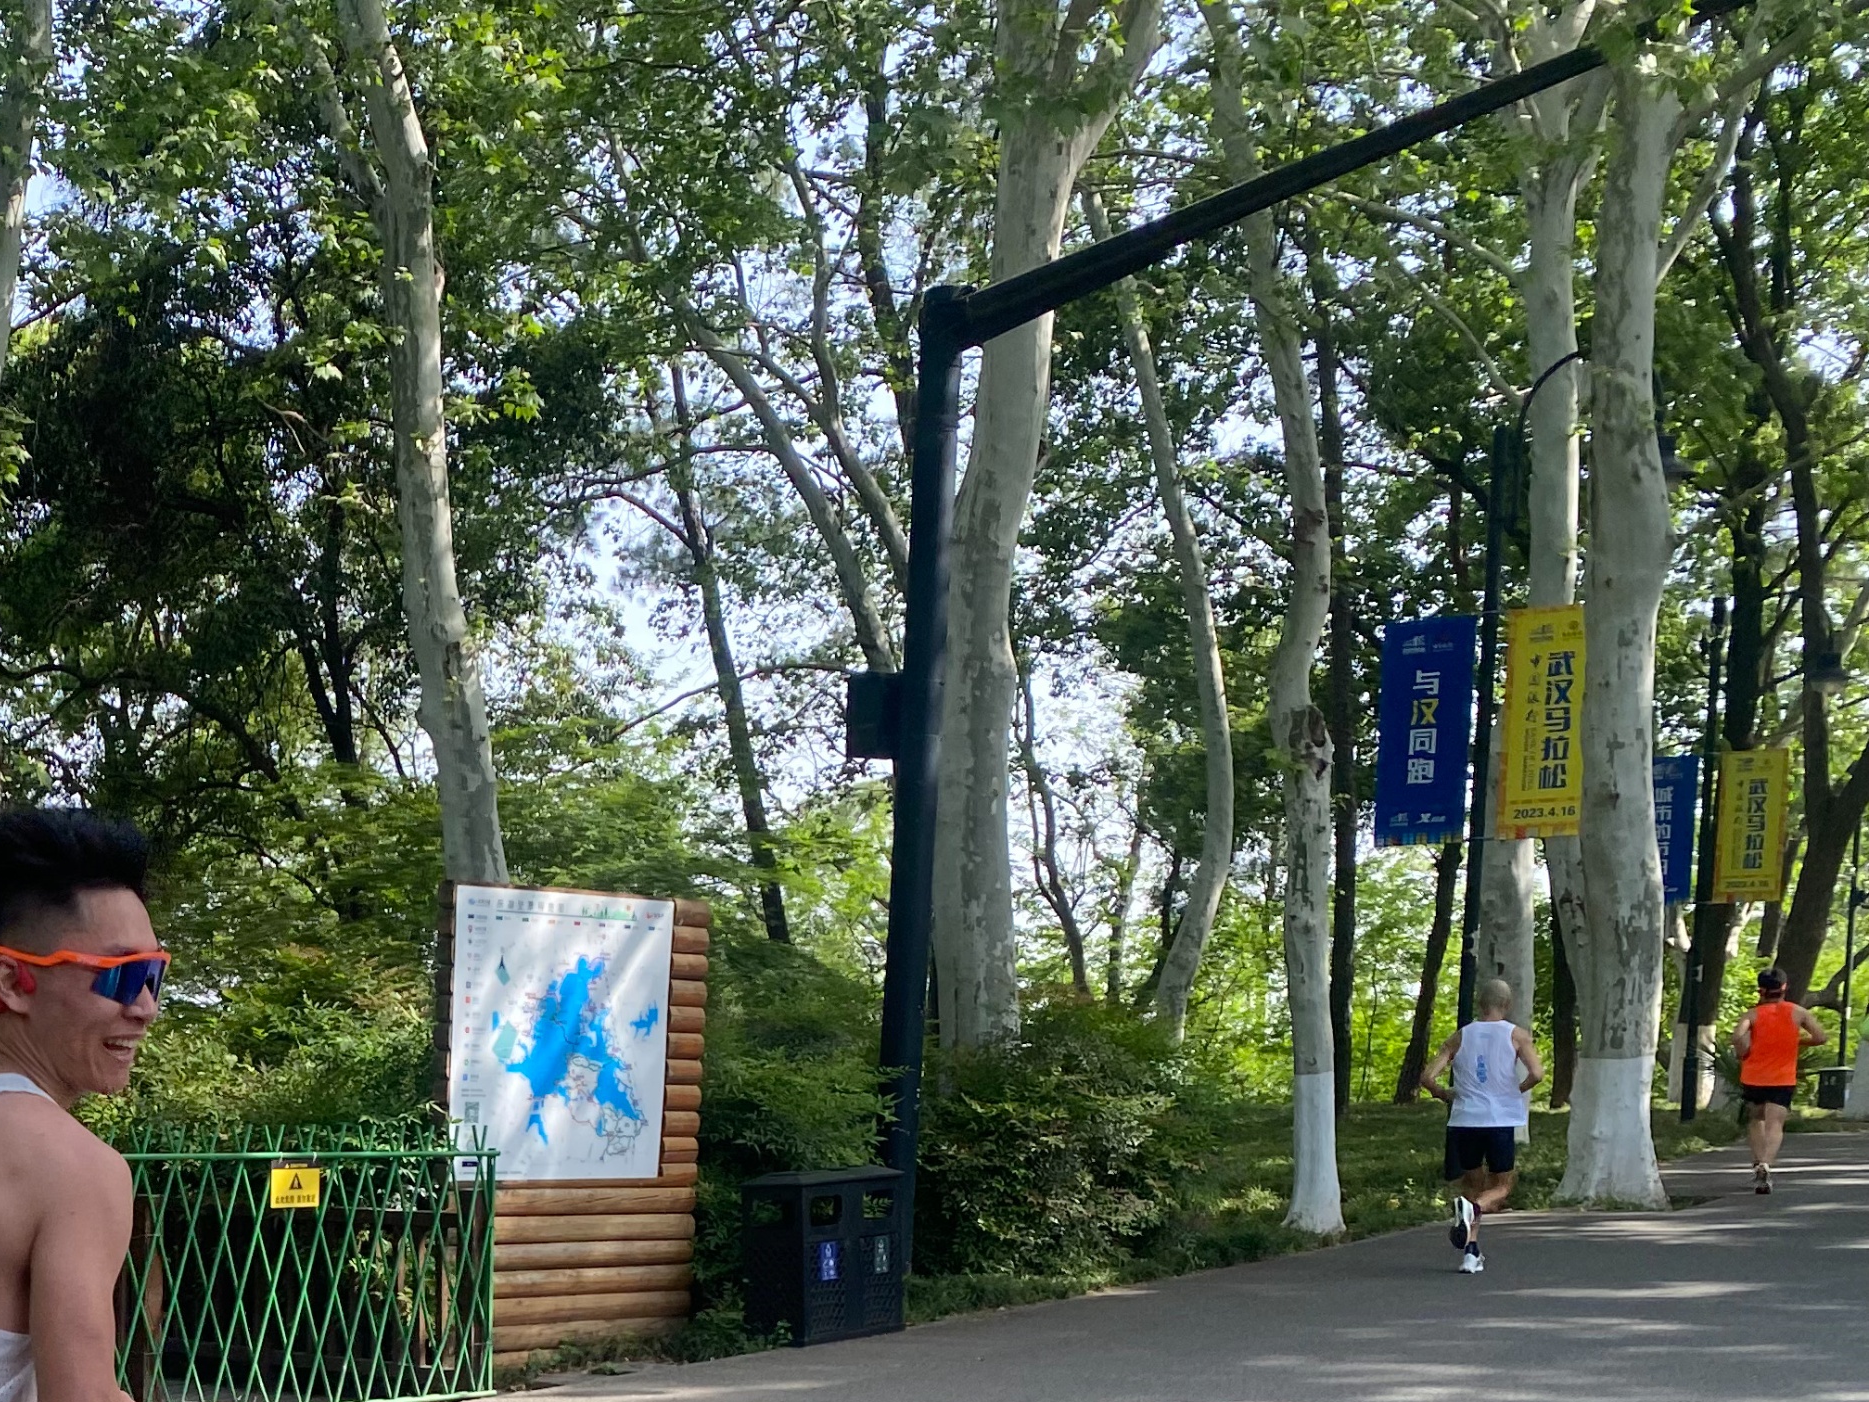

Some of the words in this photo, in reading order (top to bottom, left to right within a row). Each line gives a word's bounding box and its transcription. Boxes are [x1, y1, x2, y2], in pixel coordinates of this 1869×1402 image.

[1406, 669, 1441, 785] 与汉同跑
[1538, 651, 1576, 790] 武汉马拉松
[1513, 805, 1576, 819] 2023.4.16
[1742, 778, 1769, 869] 武汉马拉松
